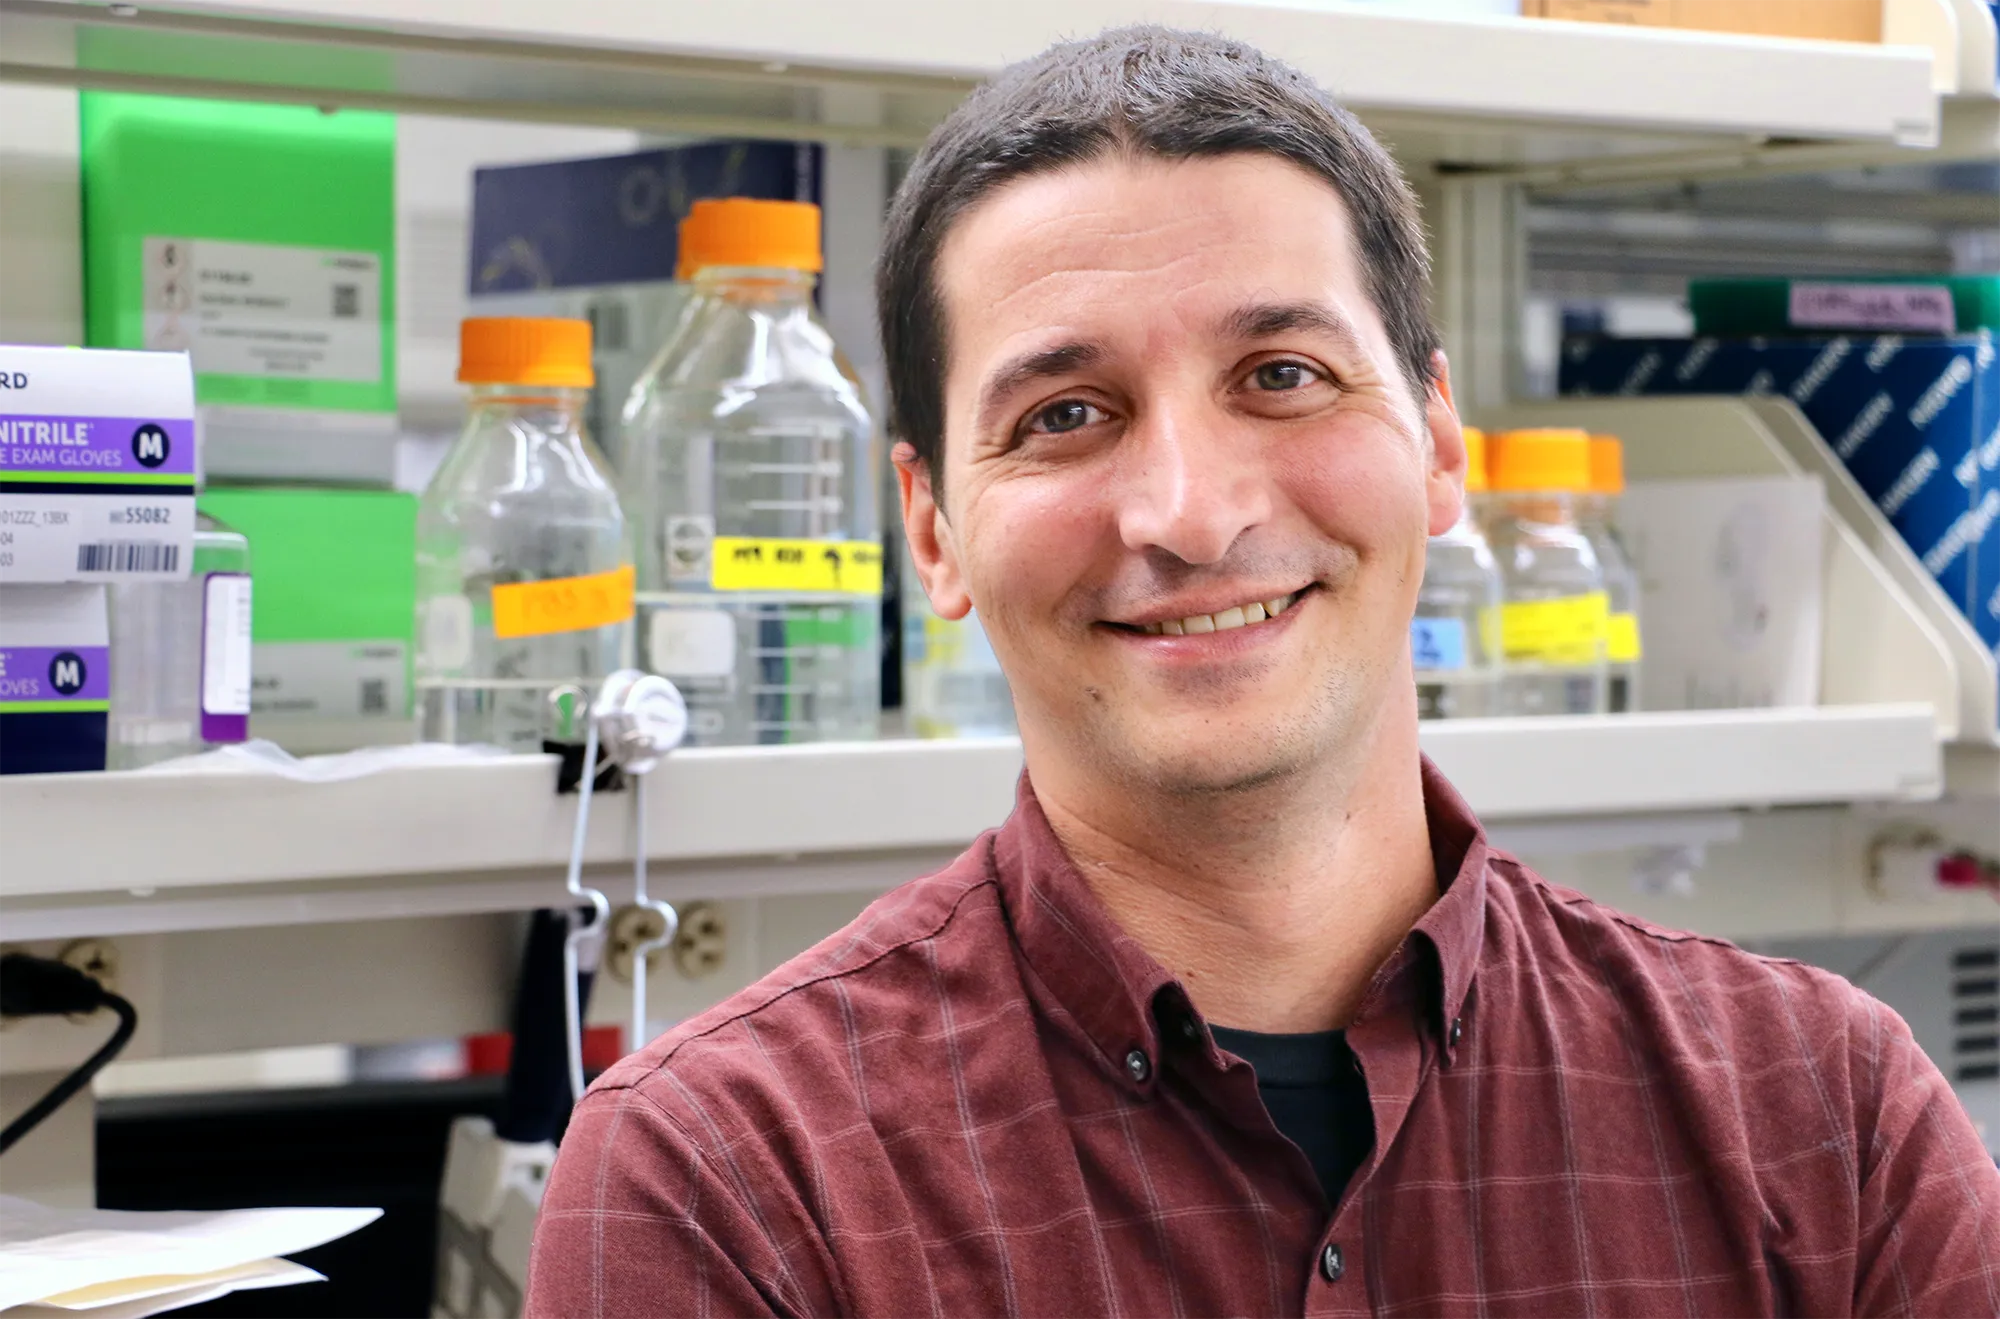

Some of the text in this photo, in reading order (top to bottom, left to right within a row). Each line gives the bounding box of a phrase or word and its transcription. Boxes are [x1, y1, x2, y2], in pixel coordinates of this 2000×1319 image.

[0, 372, 28, 390] RD
[138, 432, 164, 460] M
[12, 448, 55, 465] EXAM
[59, 448, 122, 467] GLOVES
[126, 506, 171, 524] 55082
[55, 659, 79, 688] M
